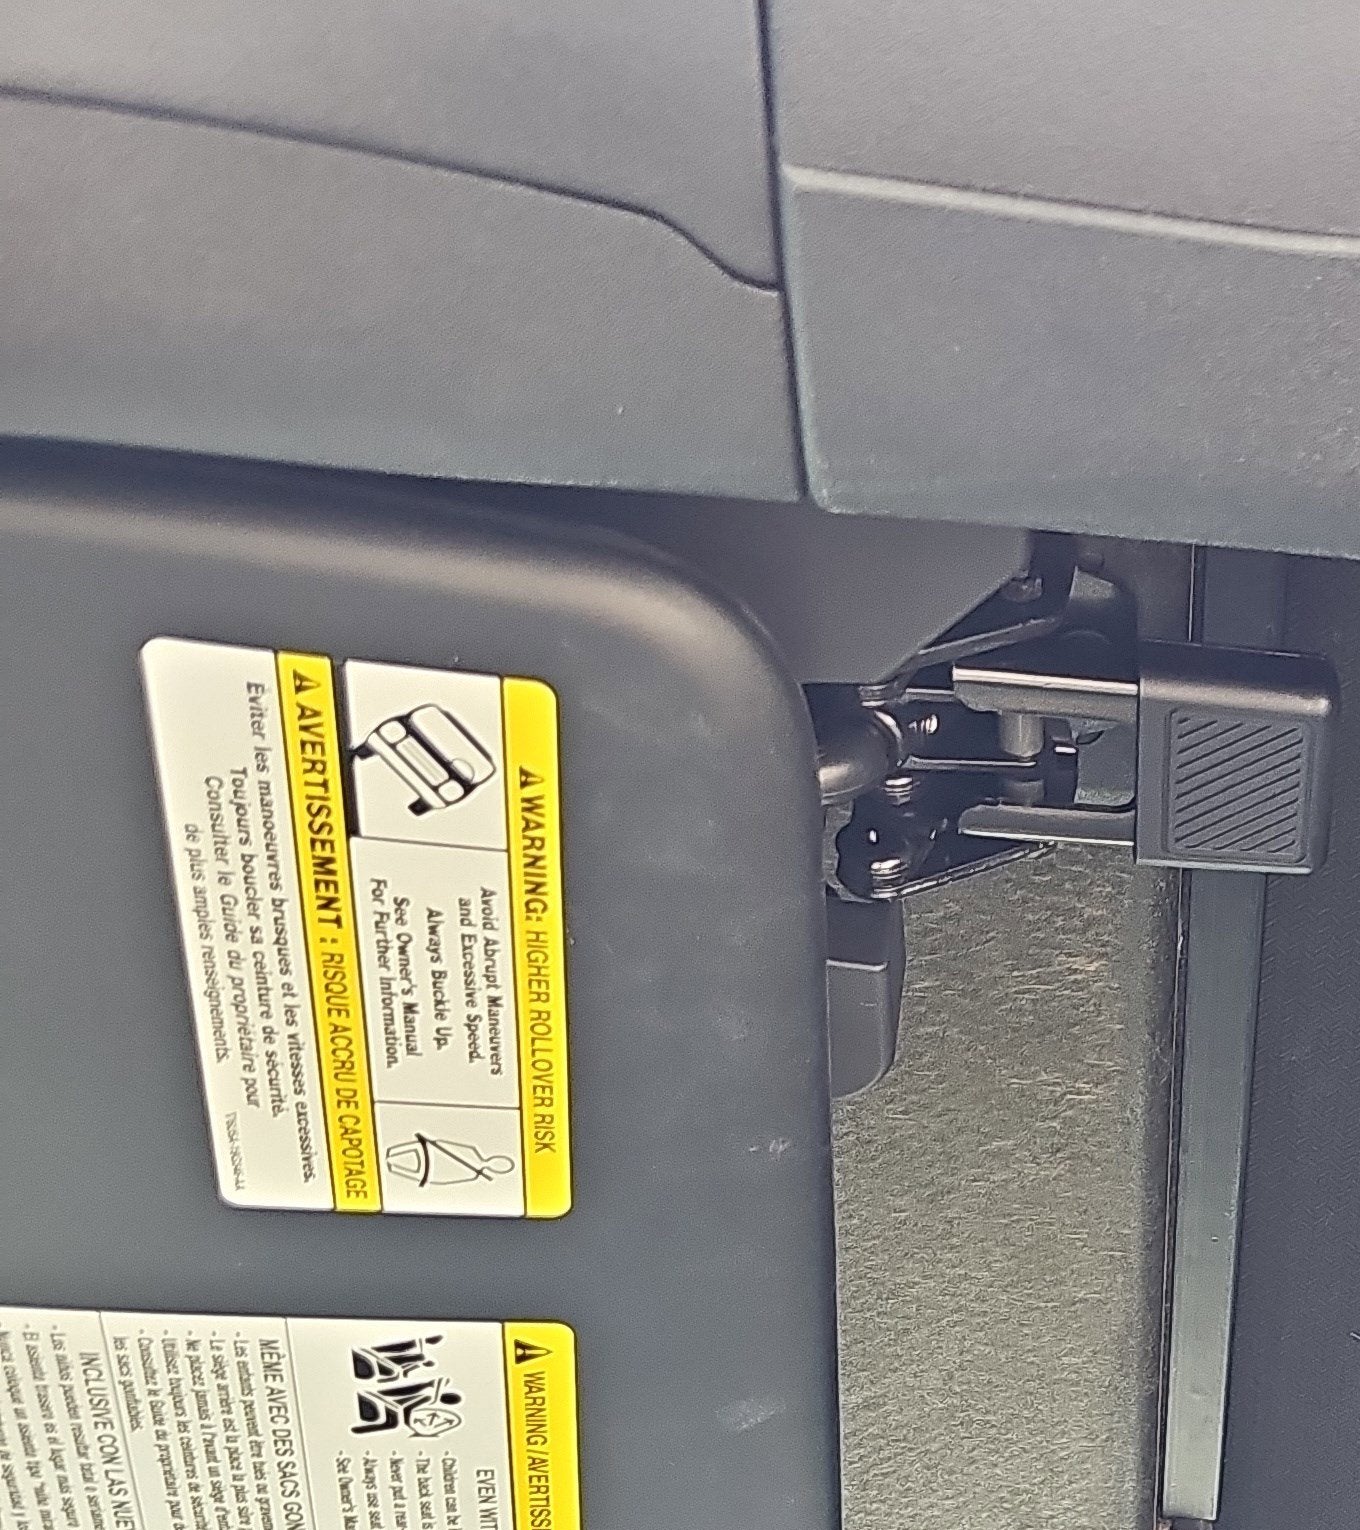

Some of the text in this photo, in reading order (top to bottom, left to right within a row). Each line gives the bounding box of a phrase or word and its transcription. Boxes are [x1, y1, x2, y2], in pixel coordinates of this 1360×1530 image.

[295, 702, 343, 929] AVERTISSEMENT
[183, 823, 233, 1064] de plus amples renseignements.
[203, 774, 259, 1108] Consulter le Guide du propriétaire pour
[224, 765, 289, 1118] Toujours boucler sa ceinture de sécurité.
[246, 681, 319, 1183] Éviter les manoeuvres brusques et les vitesses excessives.
[369, 877, 402, 1069] For Further Information.
[520, 792, 555, 1153] WARNING: HIGHER ROLLOVER RISK
[320, 951, 351, 1019] RISQUE
[392, 896, 421, 1056] See Owner's Manual
[422, 907, 452, 1051] Always Buckle Up.
[458, 897, 483, 1064] and Excessive Speed.
[479, 886, 505, 1076] Avoid Abrupt Maneuvers
[327, 1022, 357, 1082] ACCRU
[334, 1087, 359, 1110] DE
[336, 1114, 368, 1199] CAPOTAGE
[76, 1352, 116, 1430] INCLUSIVE
[264, 1386, 290, 1424] AVEC
[522, 1371, 547, 1446] WARNING
[94, 1434, 123, 1465] CON
[102, 1469, 130, 1496] LAS
[271, 1428, 295, 1456] DES
[276, 1460, 301, 1497] SACS
[475, 1469, 497, 1503] EVEN
